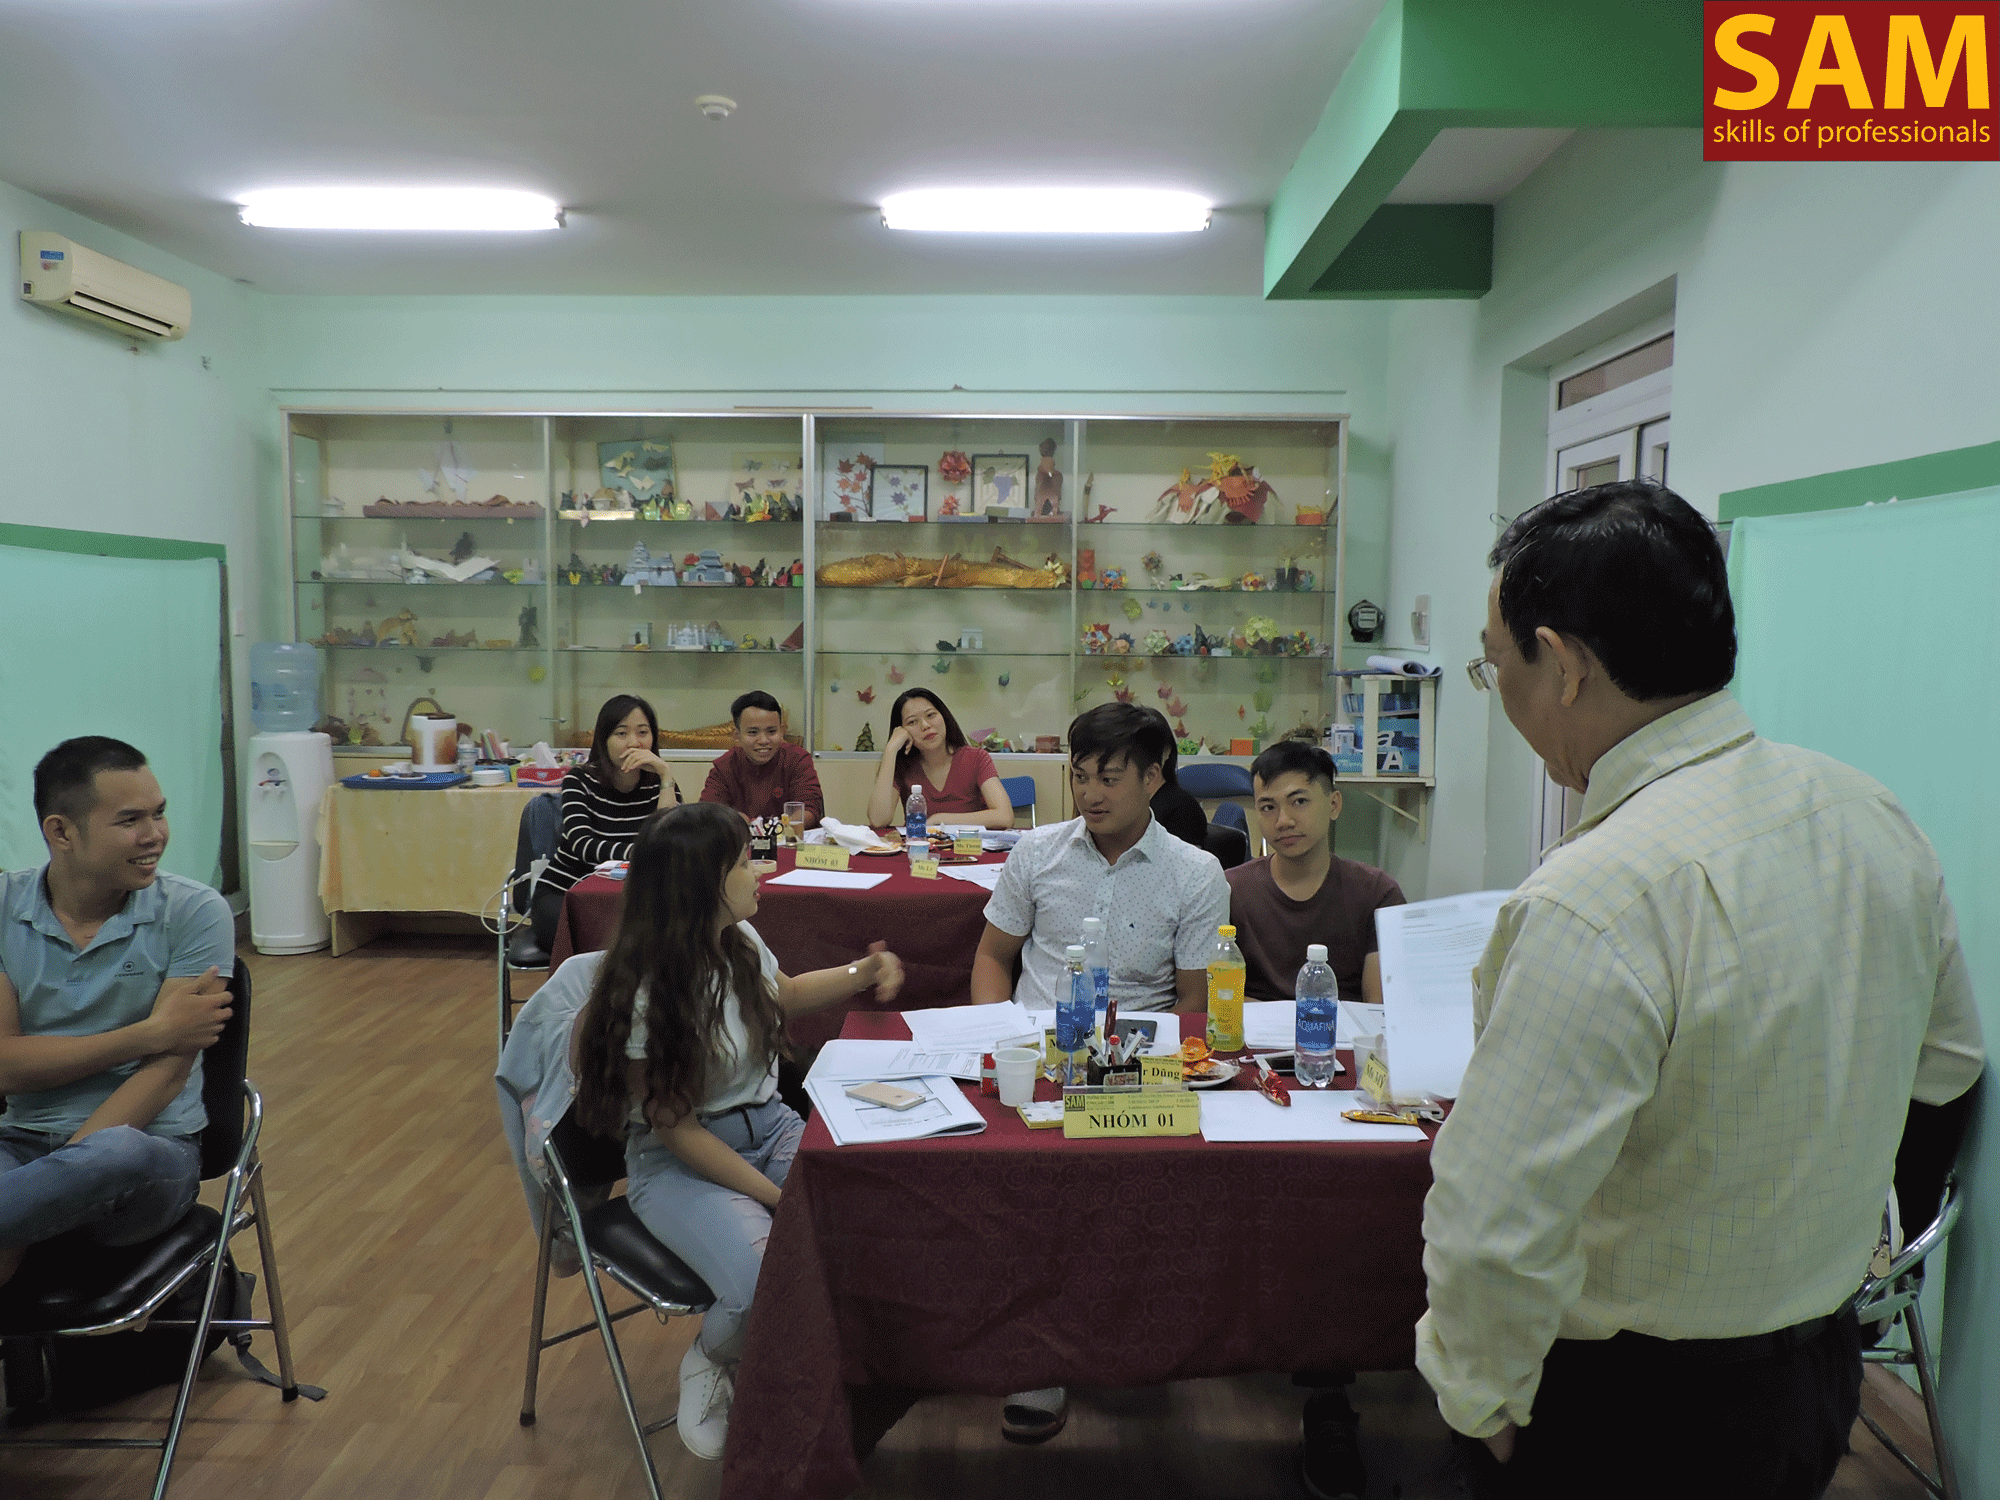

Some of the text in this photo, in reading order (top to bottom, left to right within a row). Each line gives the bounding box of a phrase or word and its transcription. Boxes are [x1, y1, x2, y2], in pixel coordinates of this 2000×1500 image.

[1065, 1094, 1086, 1108] SAM
[1089, 1109, 1174, 1128] NHÓM 01
